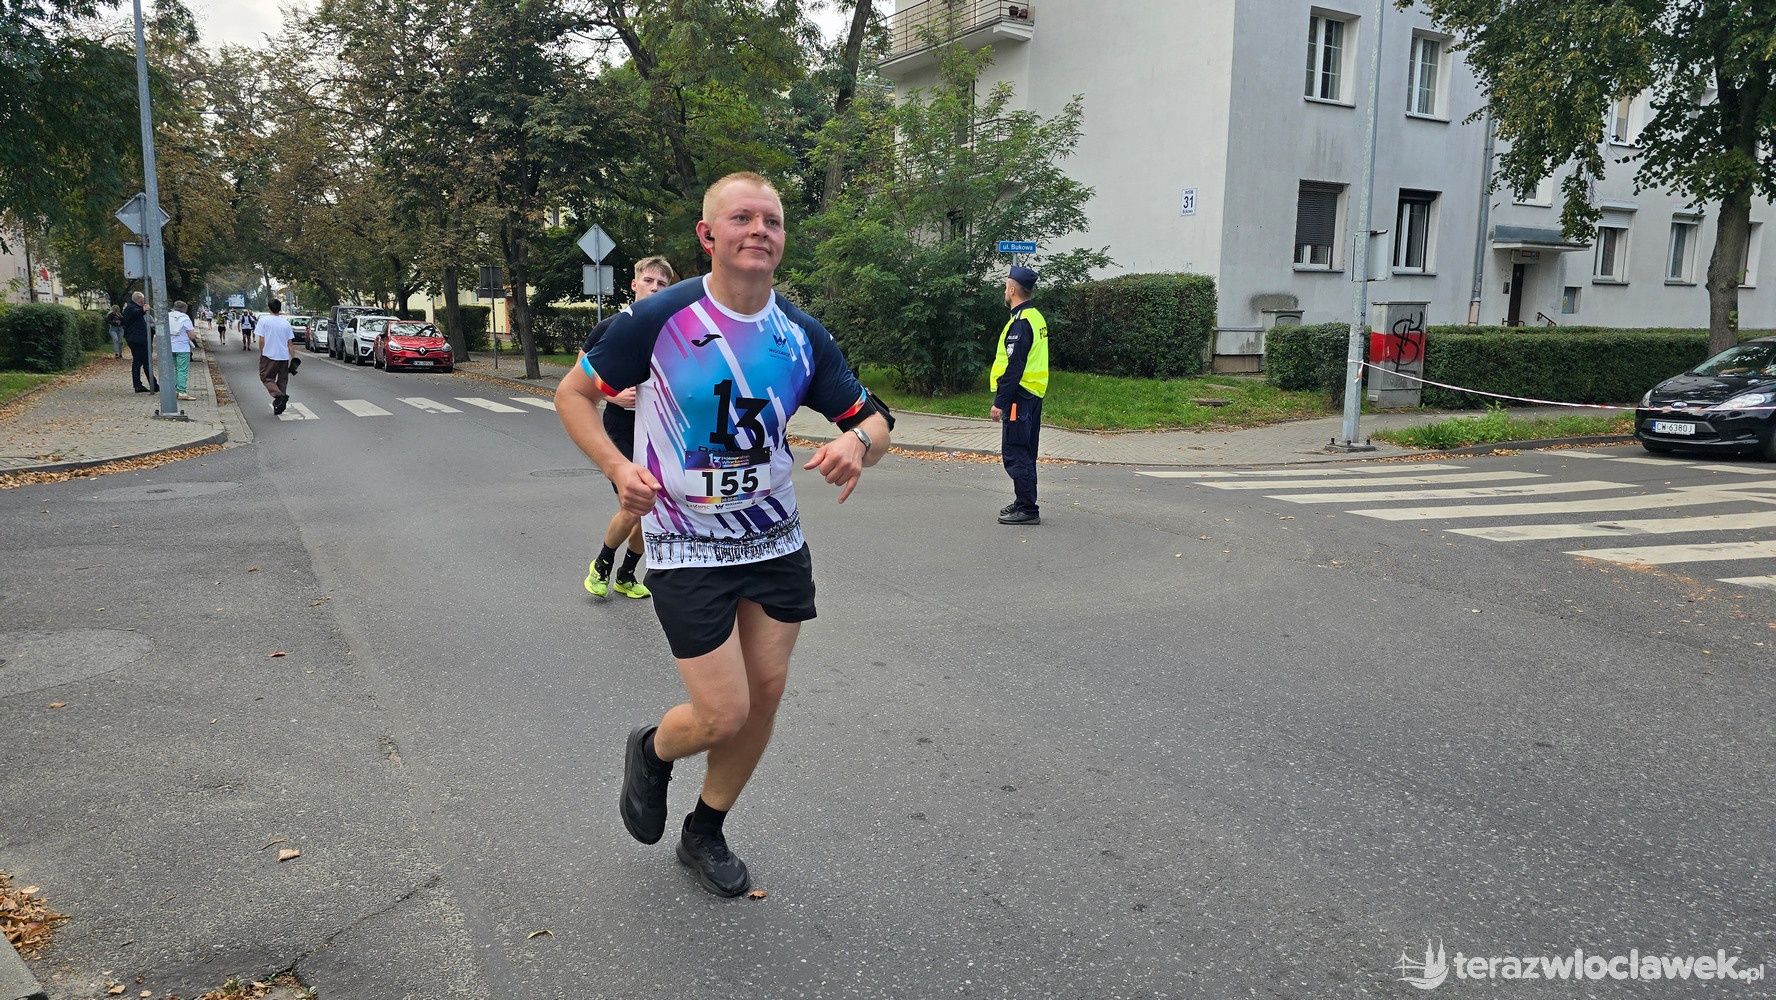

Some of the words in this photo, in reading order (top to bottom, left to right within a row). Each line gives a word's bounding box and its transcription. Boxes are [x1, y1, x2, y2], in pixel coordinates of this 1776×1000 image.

[1183, 195, 1194, 209] 31
[1010, 243, 1033, 251] Bukowa
[709, 379, 769, 450] 13
[1668, 424, 1693, 432] 6380J
[702, 468, 759, 497] 155
